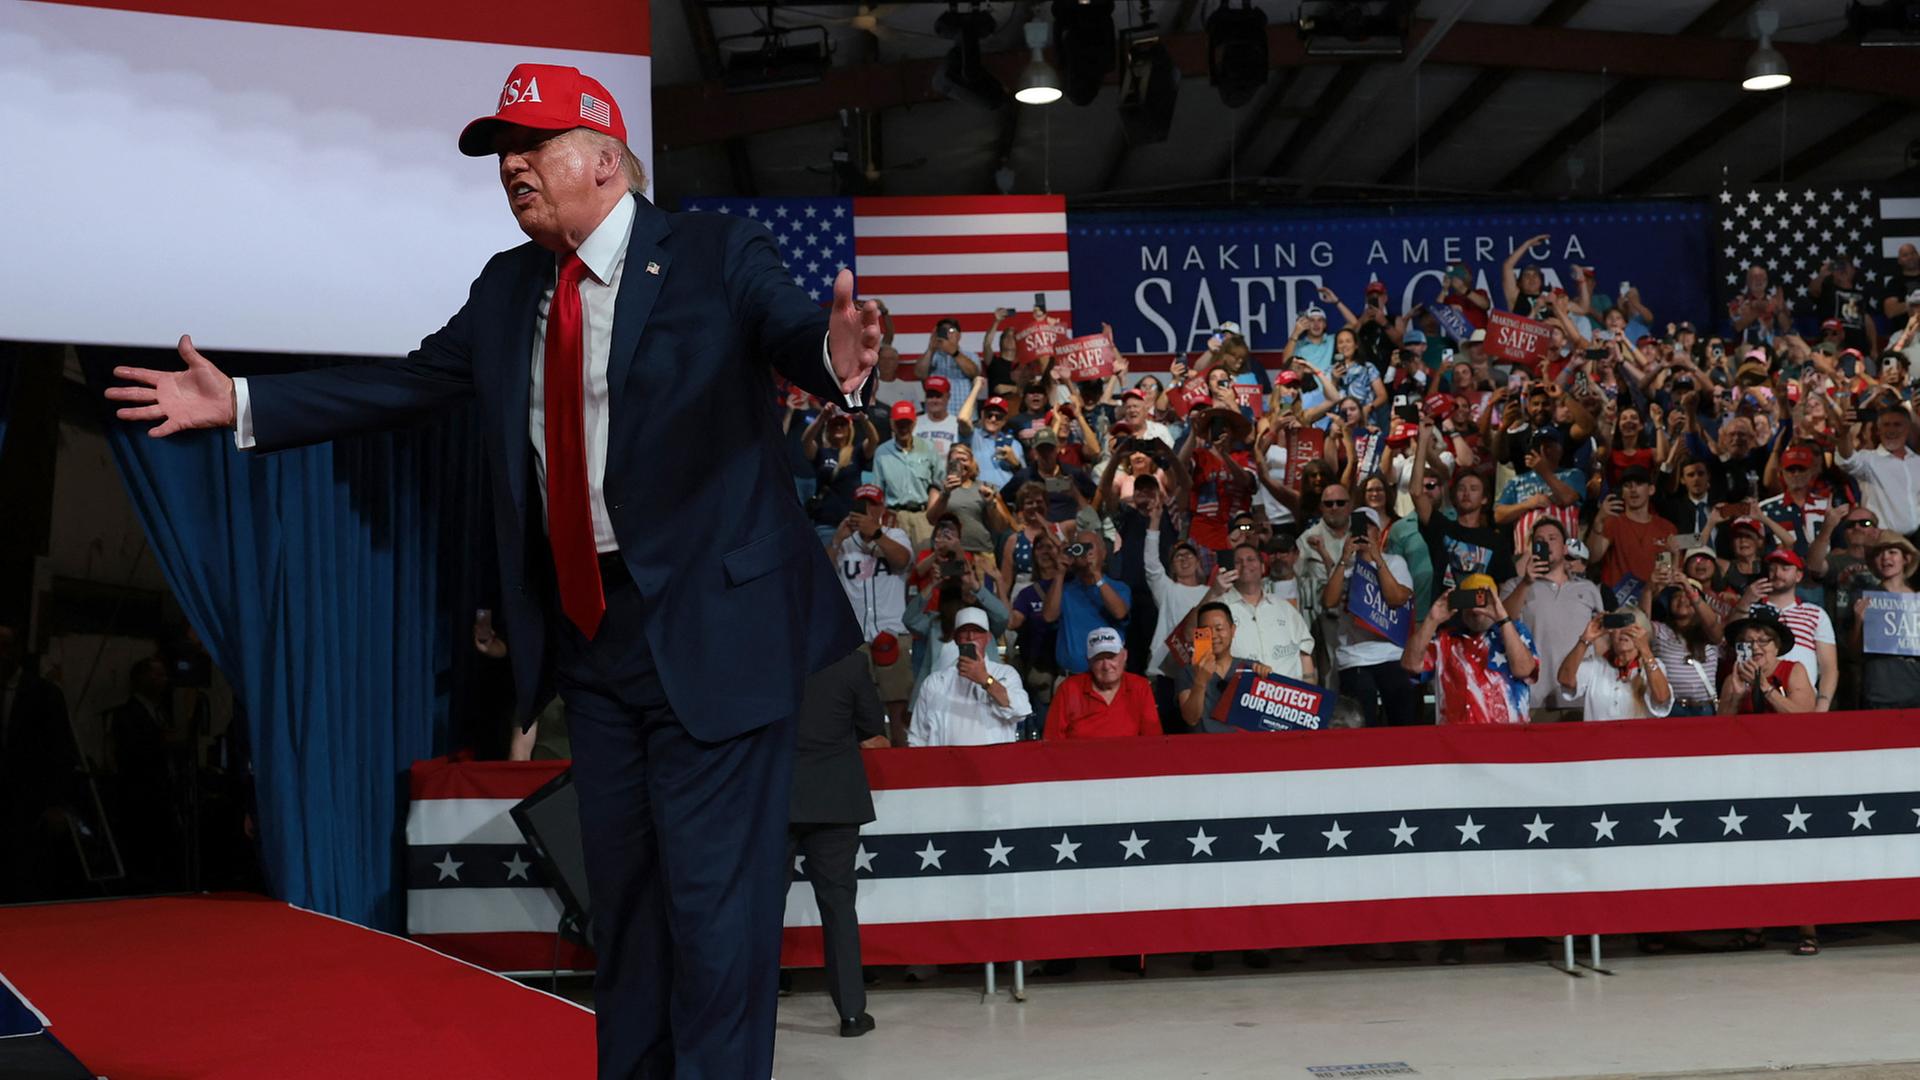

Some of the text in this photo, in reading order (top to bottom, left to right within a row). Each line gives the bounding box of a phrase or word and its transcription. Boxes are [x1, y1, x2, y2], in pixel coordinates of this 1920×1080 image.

[1141, 234, 1585, 271] MAKING AMERICA
[1025, 331, 1057, 351] SAFE
[1498, 326, 1538, 352] SAFE
[1068, 348, 1104, 370] SAFE
[1256, 681, 1317, 710] PROTECT
[1240, 692, 1321, 731] OUR BORDERS
